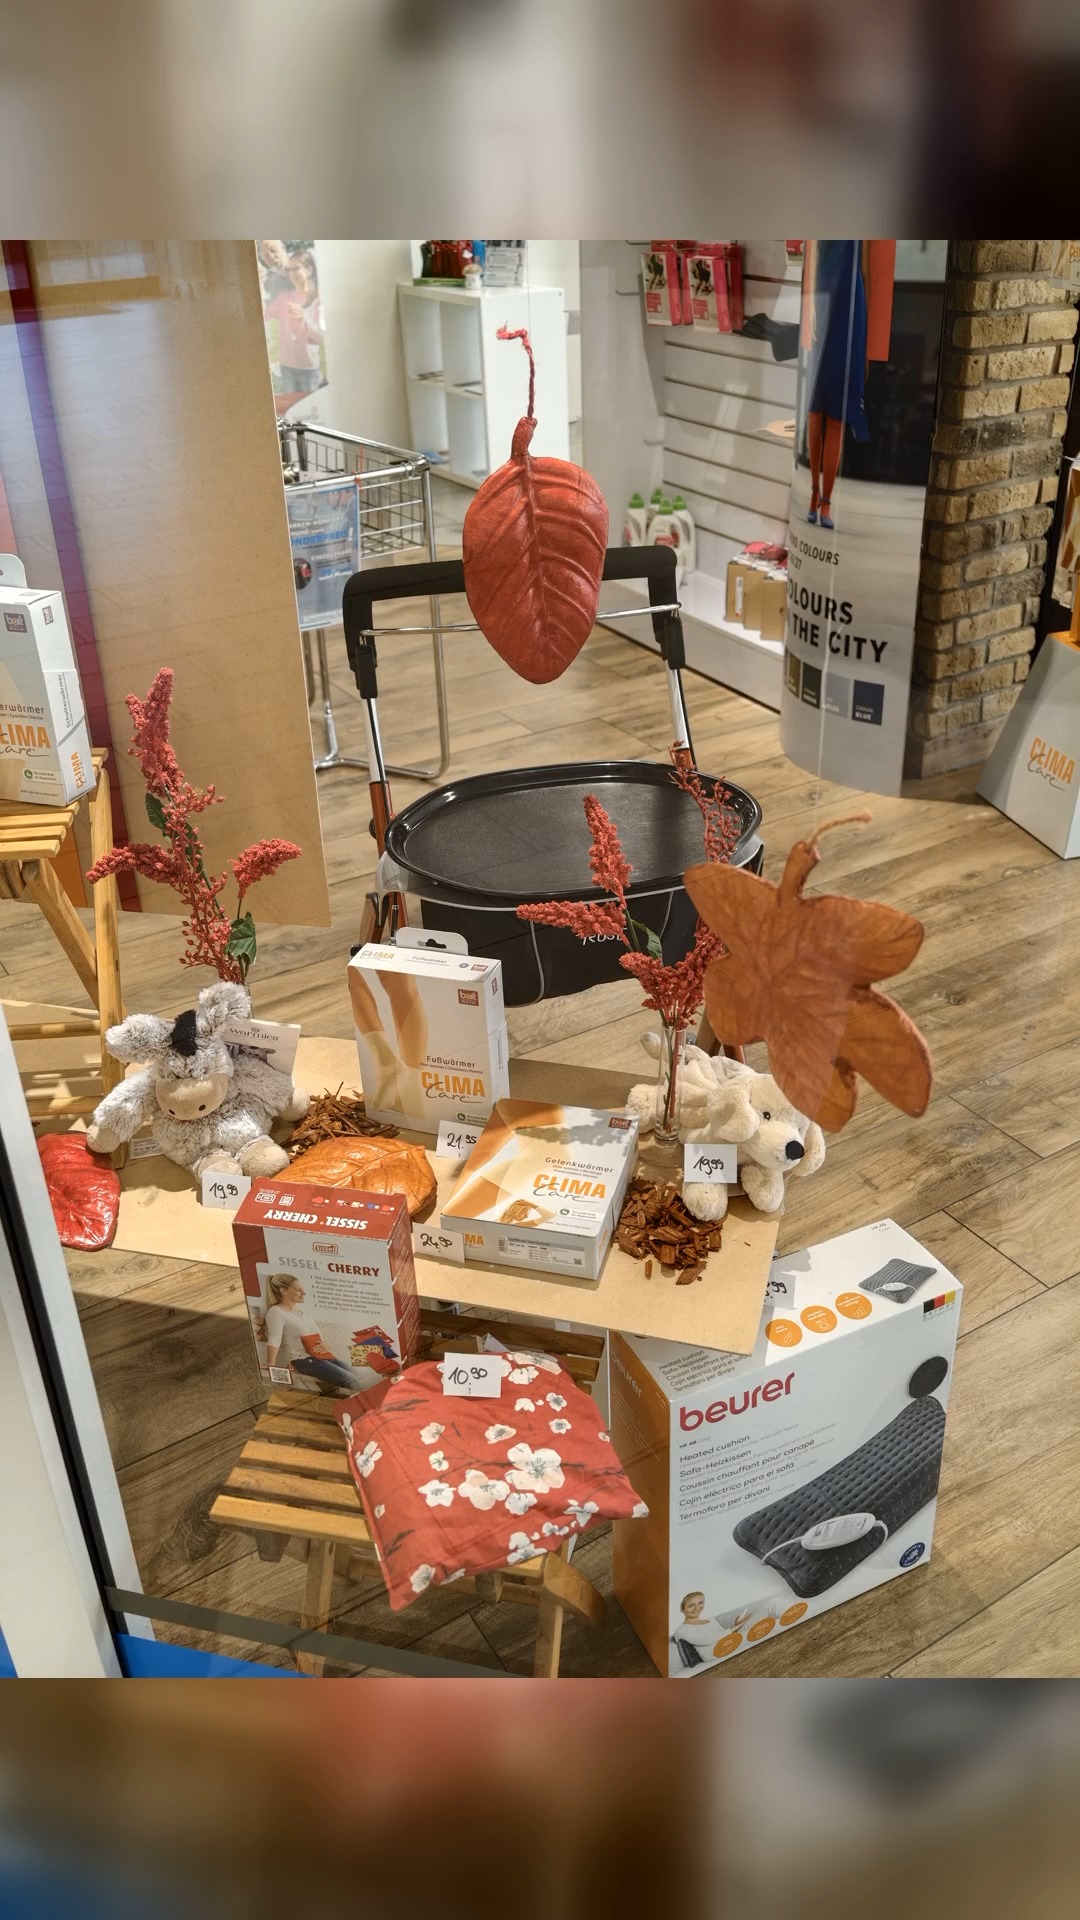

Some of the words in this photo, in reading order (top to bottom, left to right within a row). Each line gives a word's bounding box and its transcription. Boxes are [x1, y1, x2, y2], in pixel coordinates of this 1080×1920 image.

[799, 541, 840, 565] COLOURS
[789, 578, 853, 625] OLOURS
[793, 612, 819, 648] THE
[829, 631, 888, 663] CITY
[0, 703, 44, 714] erwärmer
[0, 723, 51, 748] LIMA
[0, 745, 50, 758] are
[1030, 736, 1075, 785] CLIMA
[1028, 754, 1066, 792] Care
[426, 1055, 476, 1068] Fußwärmer
[421, 1071, 486, 1097] CLIMA
[426, 1081, 484, 1103] Care
[545, 1157, 614, 1173] Gelenkwärmer
[533, 1174, 606, 1199] CLIMA
[533, 1183, 599, 1203] Care
[263, 1209, 318, 1225] CHERRY
[325, 1216, 369, 1230] SISSEL
[278, 1256, 320, 1271] SISSEL
[327, 1262, 380, 1277] CHERRY
[659, 1359, 681, 1370] Heated
[682, 1350, 705, 1361] cushion
[662, 1355, 710, 1376] Sofa-Heizkissen
[666, 1369, 690, 1381] Coussin
[690, 1358, 719, 1372] chauffant
[712, 1362, 727, 1371] para
[674, 1378, 705, 1392] Termoforo
[706, 1373, 716, 1382] per
[717, 1366, 736, 1376] divani
[680, 1372, 795, 1432] beurer
[680, 1447, 714, 1462] Heated
[716, 1435, 750, 1452] cushion
[680, 1450, 752, 1477] Sofa-Heizkissen
[680, 1477, 715, 1492] Coussin
[716, 1460, 760, 1481] chauffant
[762, 1452, 782, 1466] pour
[783, 1438, 815, 1456] canapé
[704, 1482, 742, 1499] eléctrico
[743, 1474, 764, 1487] para
[767, 1469, 774, 1477] el
[680, 1502, 725, 1520] Termoforo
[727, 1496, 743, 1507] per
[744, 1484, 770, 1500] divani
